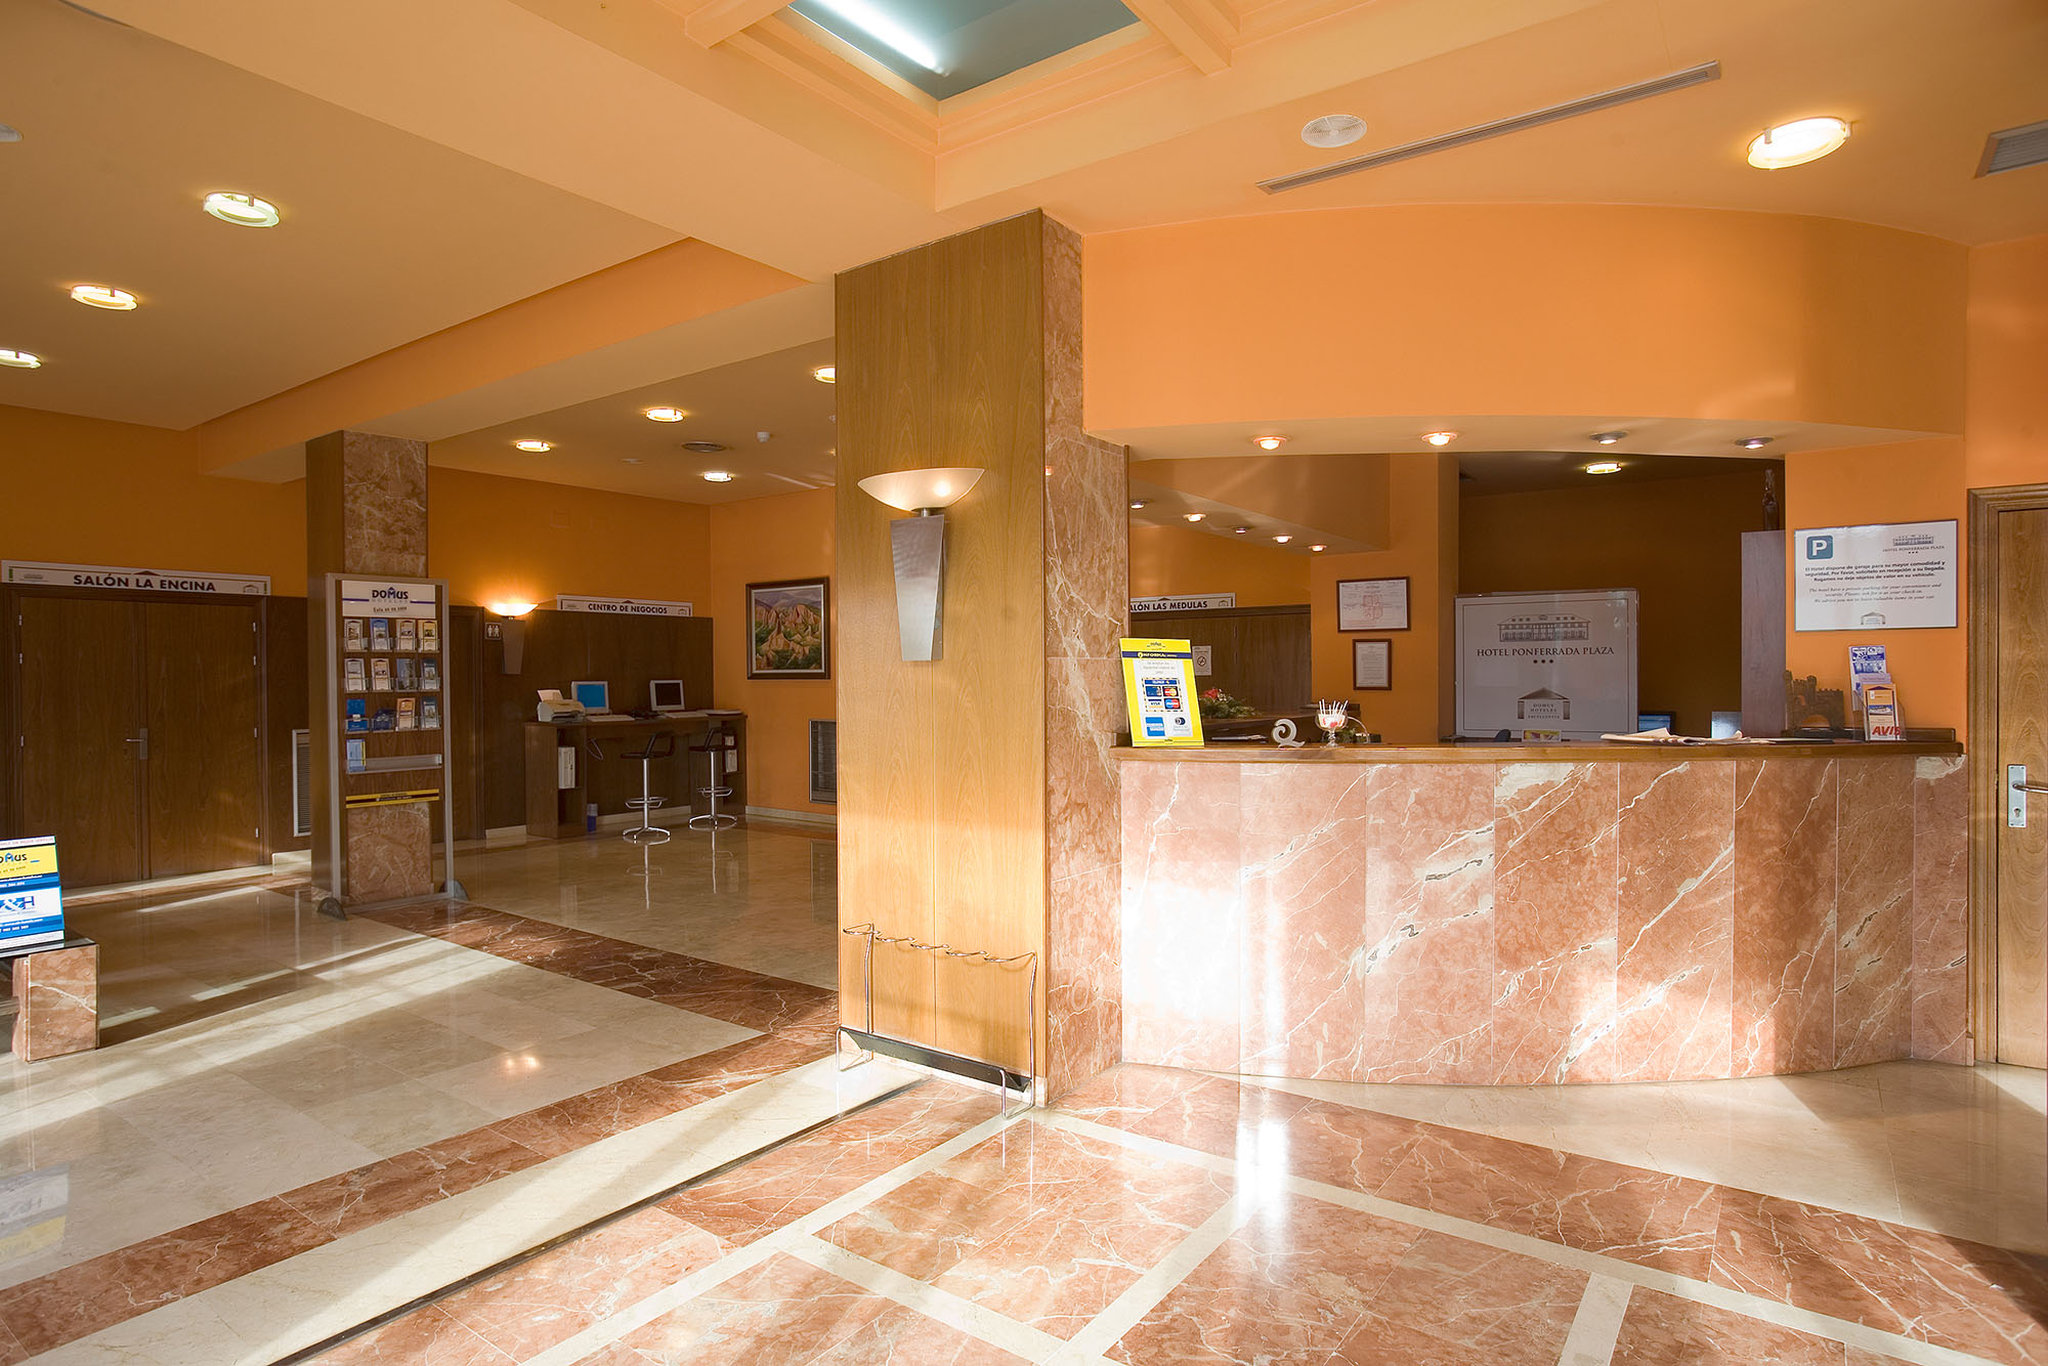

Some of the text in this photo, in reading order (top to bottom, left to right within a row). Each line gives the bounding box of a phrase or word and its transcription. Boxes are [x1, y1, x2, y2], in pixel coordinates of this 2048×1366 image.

[1812, 539, 1828, 556] P
[73, 574, 216, 592] SALÓN LA ENCINA
[372, 587, 408, 600] DOMUS
[588, 603, 617, 612] CENTRO
[630, 605, 668, 614] NEGOCIOS
[1152, 602, 1167, 610] LAS
[1169, 600, 1208, 610] MEDULAS
[1477, 646, 1615, 657] HOTEL PONFERRADA PLAZA
[1872, 726, 1901, 736] AVIS
